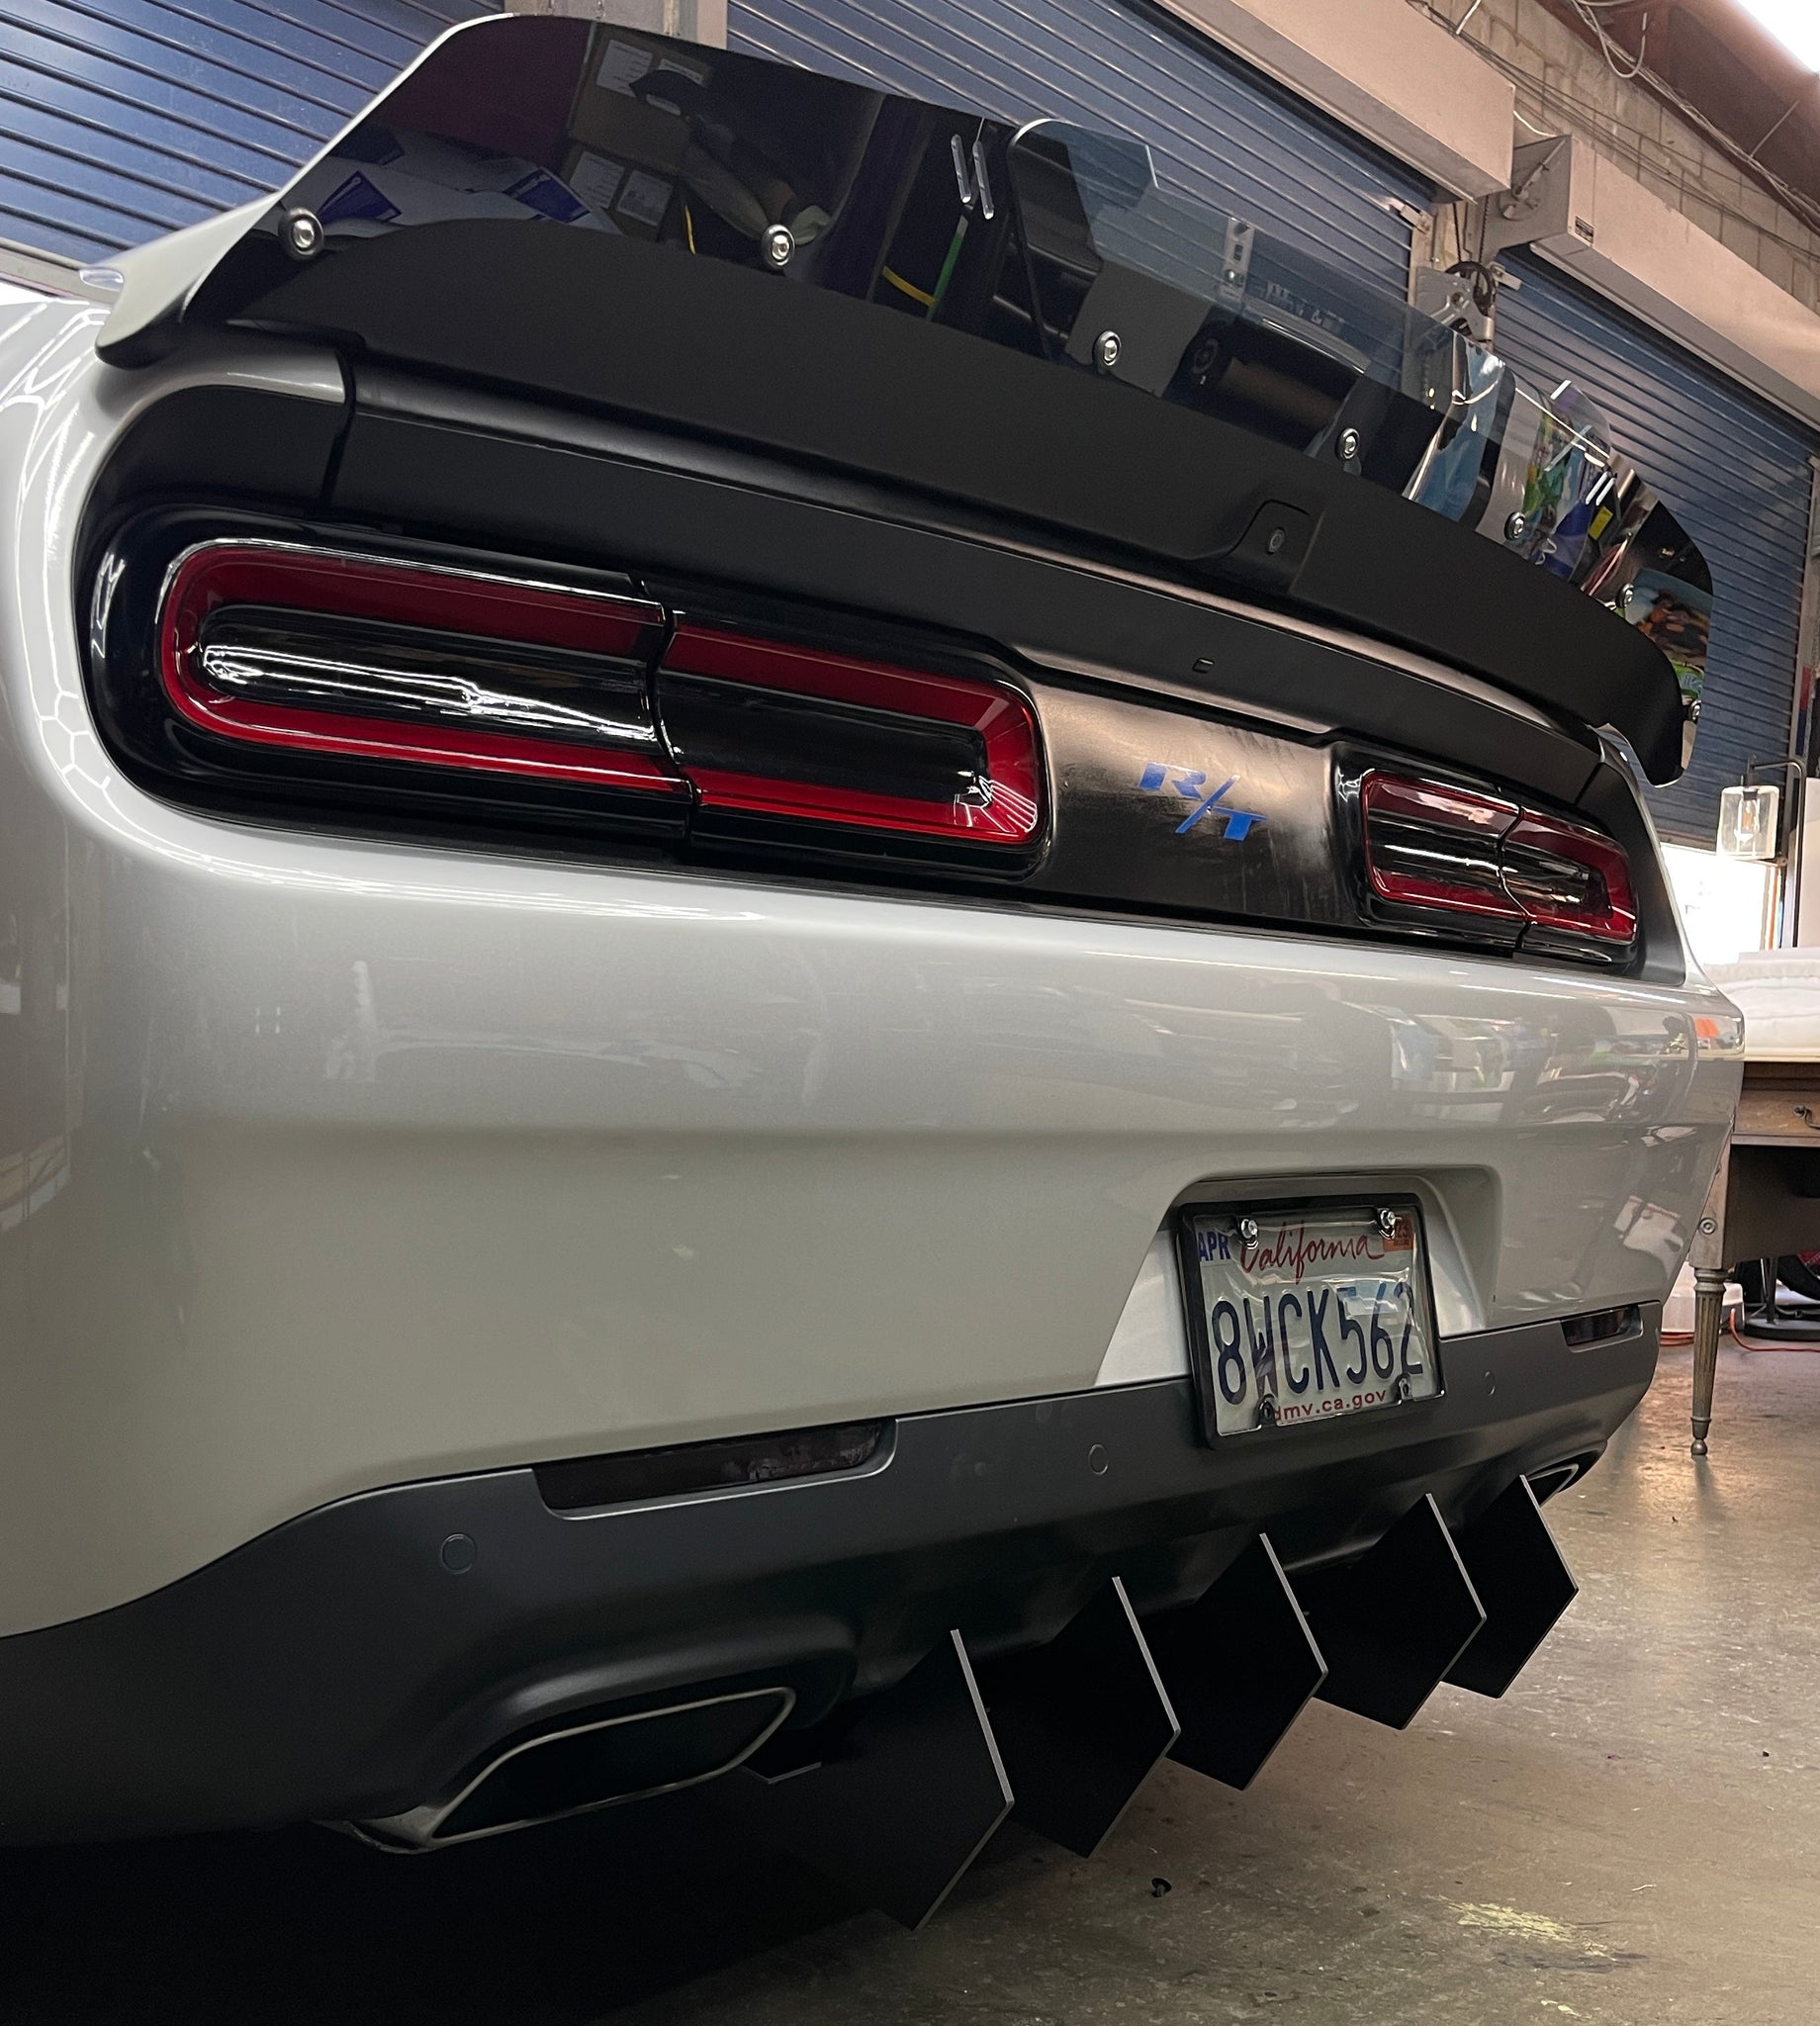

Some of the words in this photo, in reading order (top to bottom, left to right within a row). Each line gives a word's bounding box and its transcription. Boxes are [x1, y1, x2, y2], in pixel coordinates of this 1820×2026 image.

[1139, 761, 1267, 841] R/T
[1198, 1231, 1230, 1261] APR
[1240, 1220, 1385, 1284] California
[1212, 1282, 1422, 1405] 8WCK562
